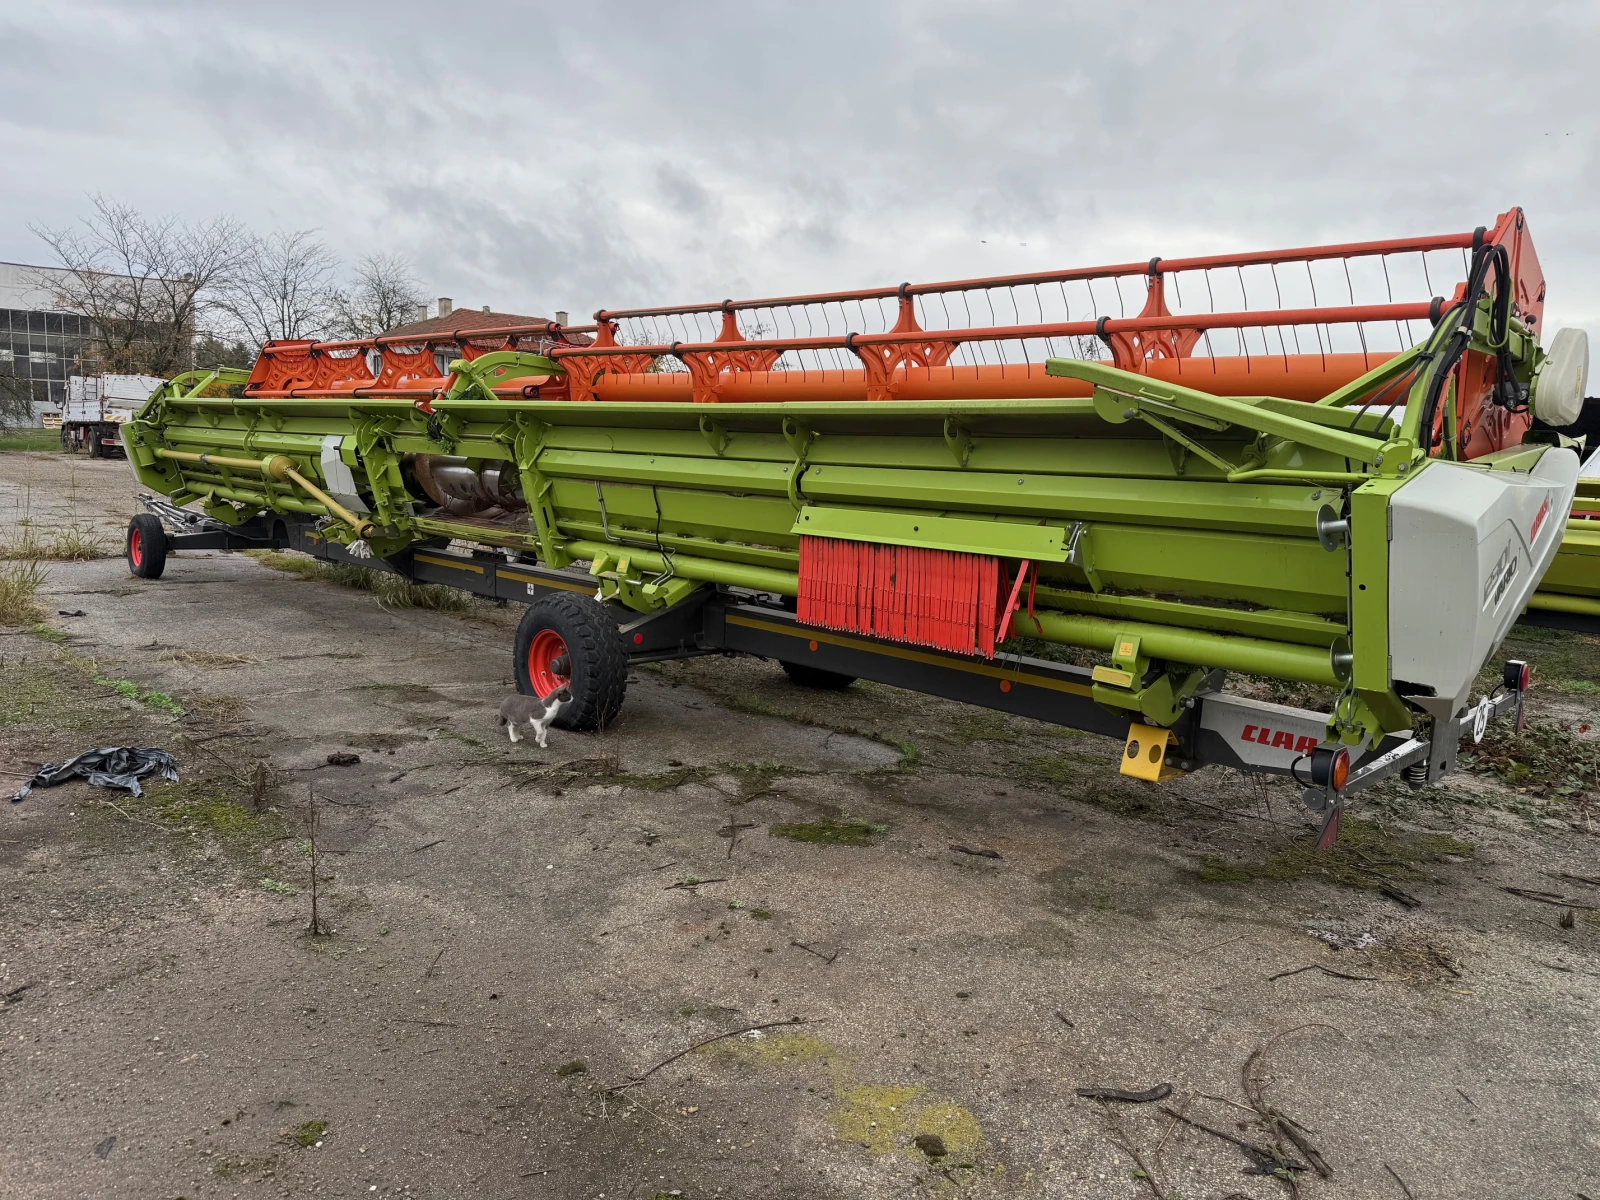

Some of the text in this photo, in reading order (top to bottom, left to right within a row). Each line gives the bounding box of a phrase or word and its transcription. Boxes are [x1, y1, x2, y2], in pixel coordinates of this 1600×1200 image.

[1494, 555, 1518, 606] VARIO
[1475, 703, 1487, 737] 25
[1241, 724, 1318, 754] CLAA
